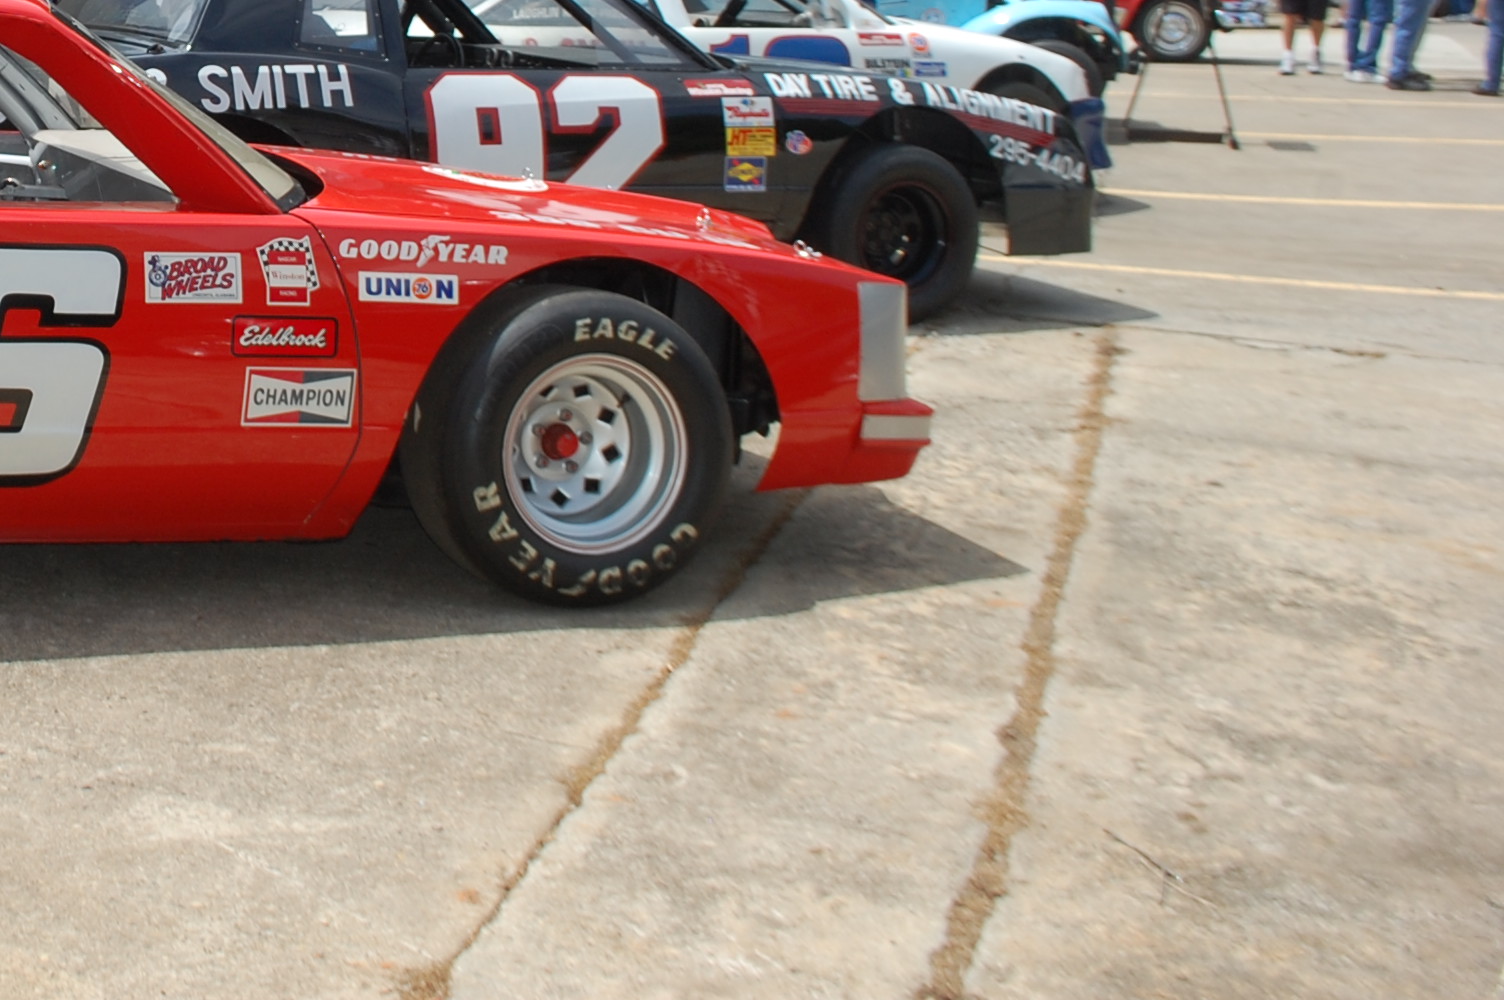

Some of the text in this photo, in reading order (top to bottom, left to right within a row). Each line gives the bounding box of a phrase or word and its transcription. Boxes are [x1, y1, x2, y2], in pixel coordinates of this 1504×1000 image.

[197, 64, 355, 114] SMITH
[764, 73, 810, 99] DAY
[811, 74, 879, 102] TIRE
[887, 78, 916, 105] &
[923, 82, 1058, 134] ALIGNMENT
[424, 71, 667, 191] 92
[989, 134, 1086, 184] 295-4404
[168, 256, 228, 281] BROAD
[271, 270, 305, 280] Winston
[161, 272, 235, 301] WHEELS
[365, 275, 455, 300] UNION
[239, 325, 327, 349] Edelbrock
[574, 317, 679, 361] EAGLE
[253, 386, 346, 408] CHAMPION
